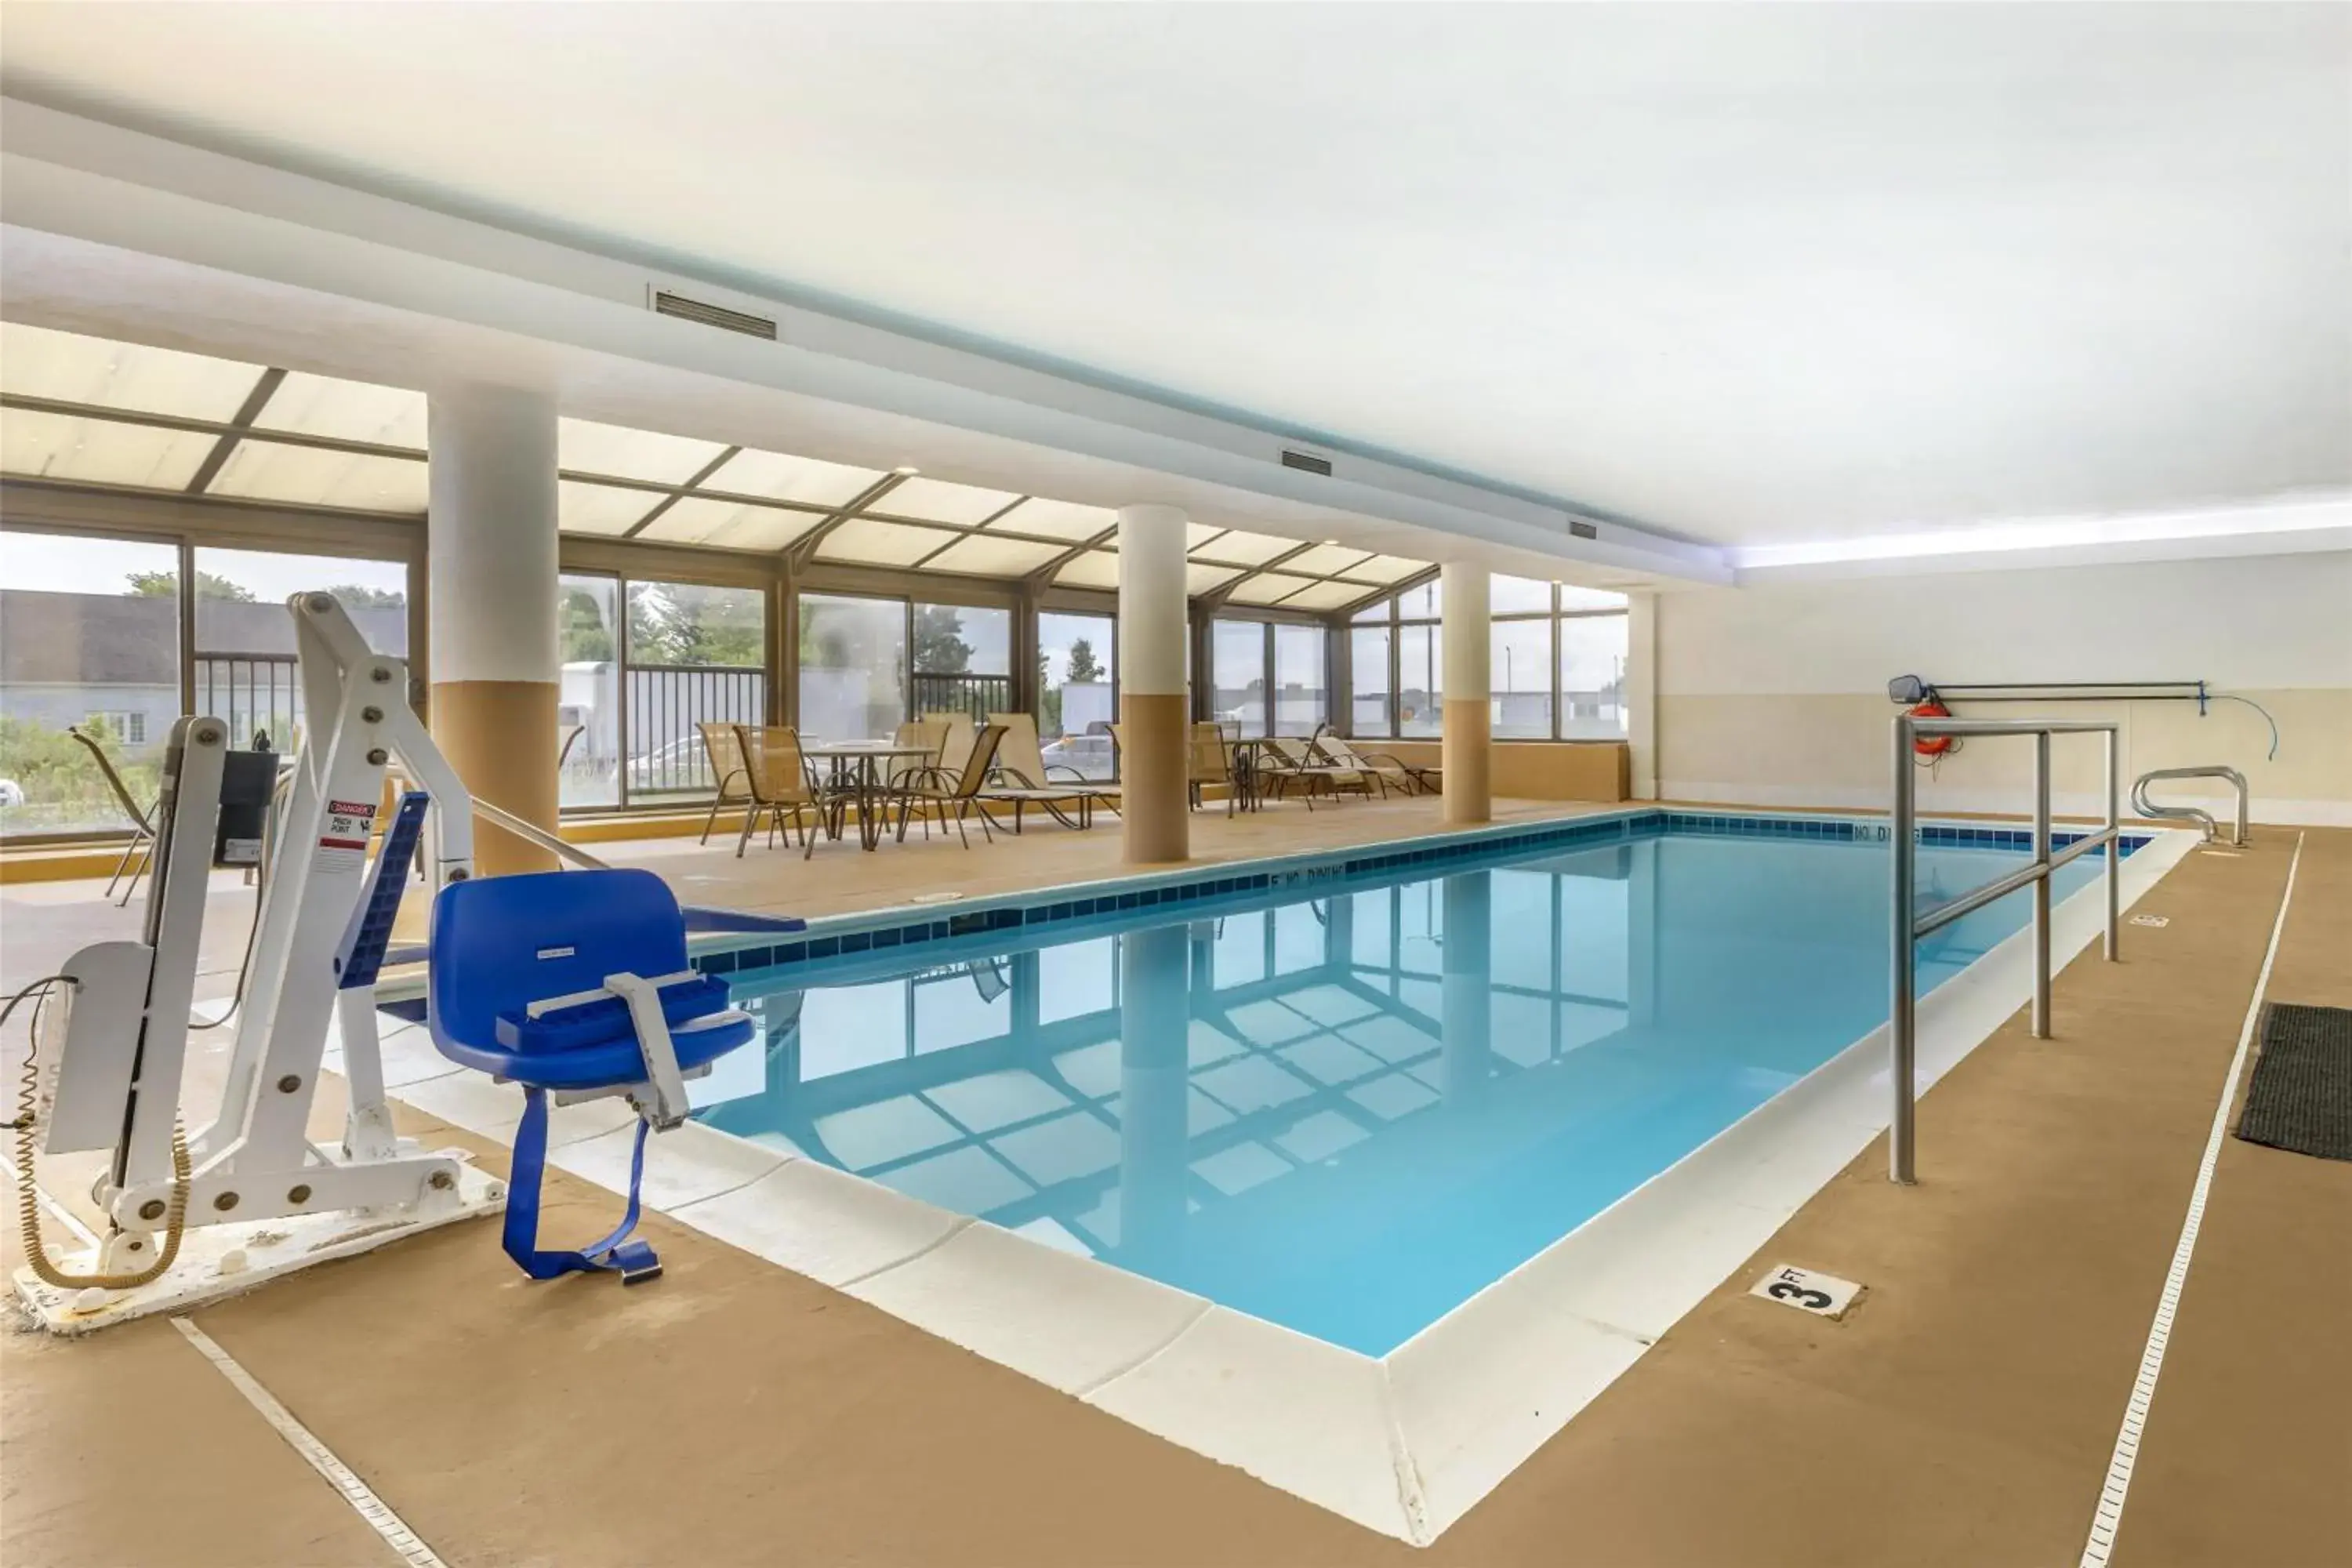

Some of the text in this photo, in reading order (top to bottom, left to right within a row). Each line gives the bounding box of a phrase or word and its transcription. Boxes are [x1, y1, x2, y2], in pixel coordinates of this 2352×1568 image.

[335, 803, 368, 815] DANGER
[1768, 1268, 1832, 1309] 3 FT
